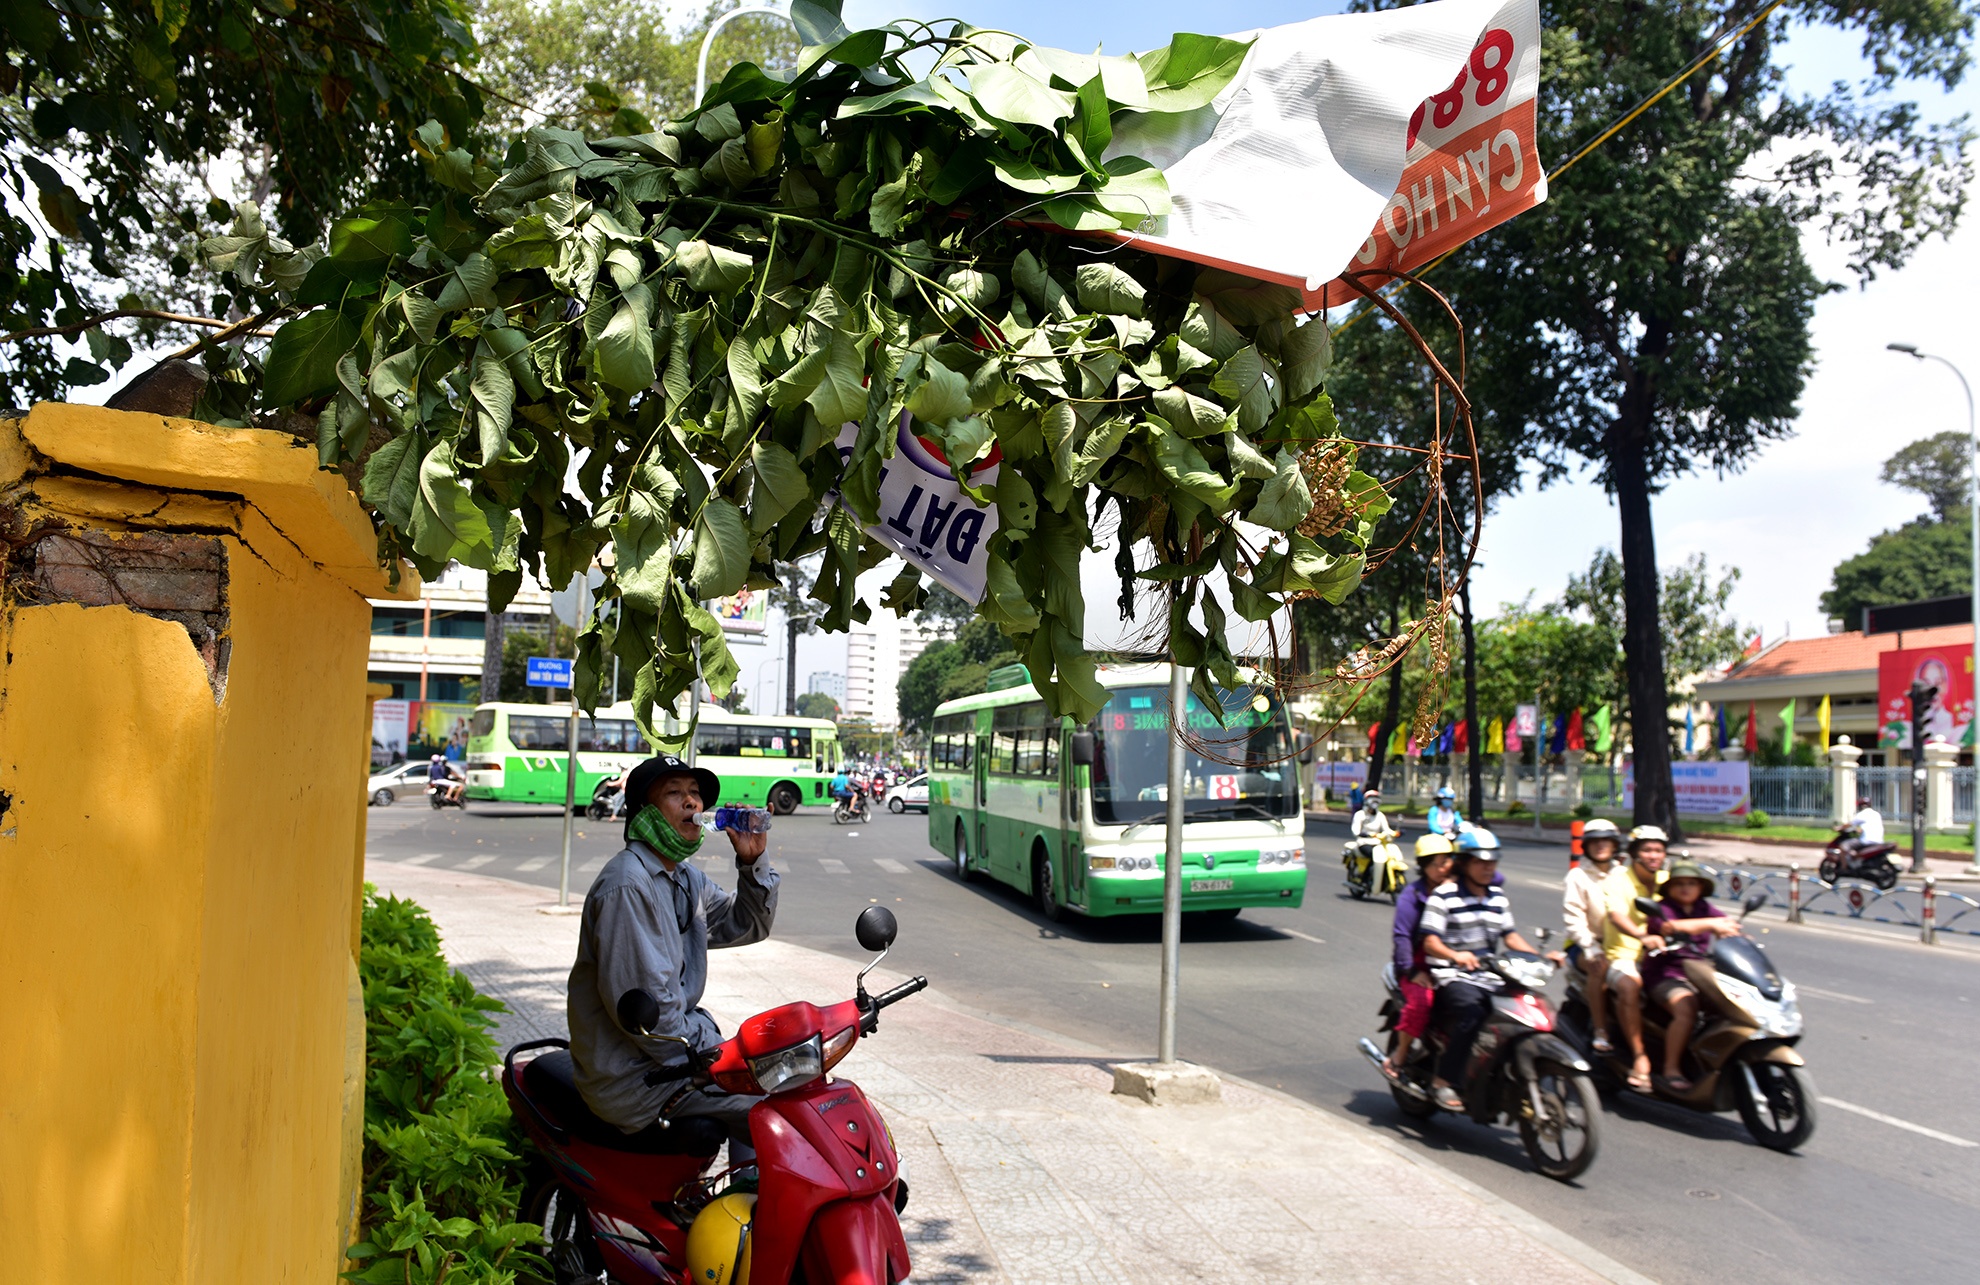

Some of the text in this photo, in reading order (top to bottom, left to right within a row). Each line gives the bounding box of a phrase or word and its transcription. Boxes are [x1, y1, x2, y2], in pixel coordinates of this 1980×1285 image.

[1406, 29, 1514, 152] 88
[1114, 714, 1125, 730] 8
[1215, 774, 1237, 800] 8
